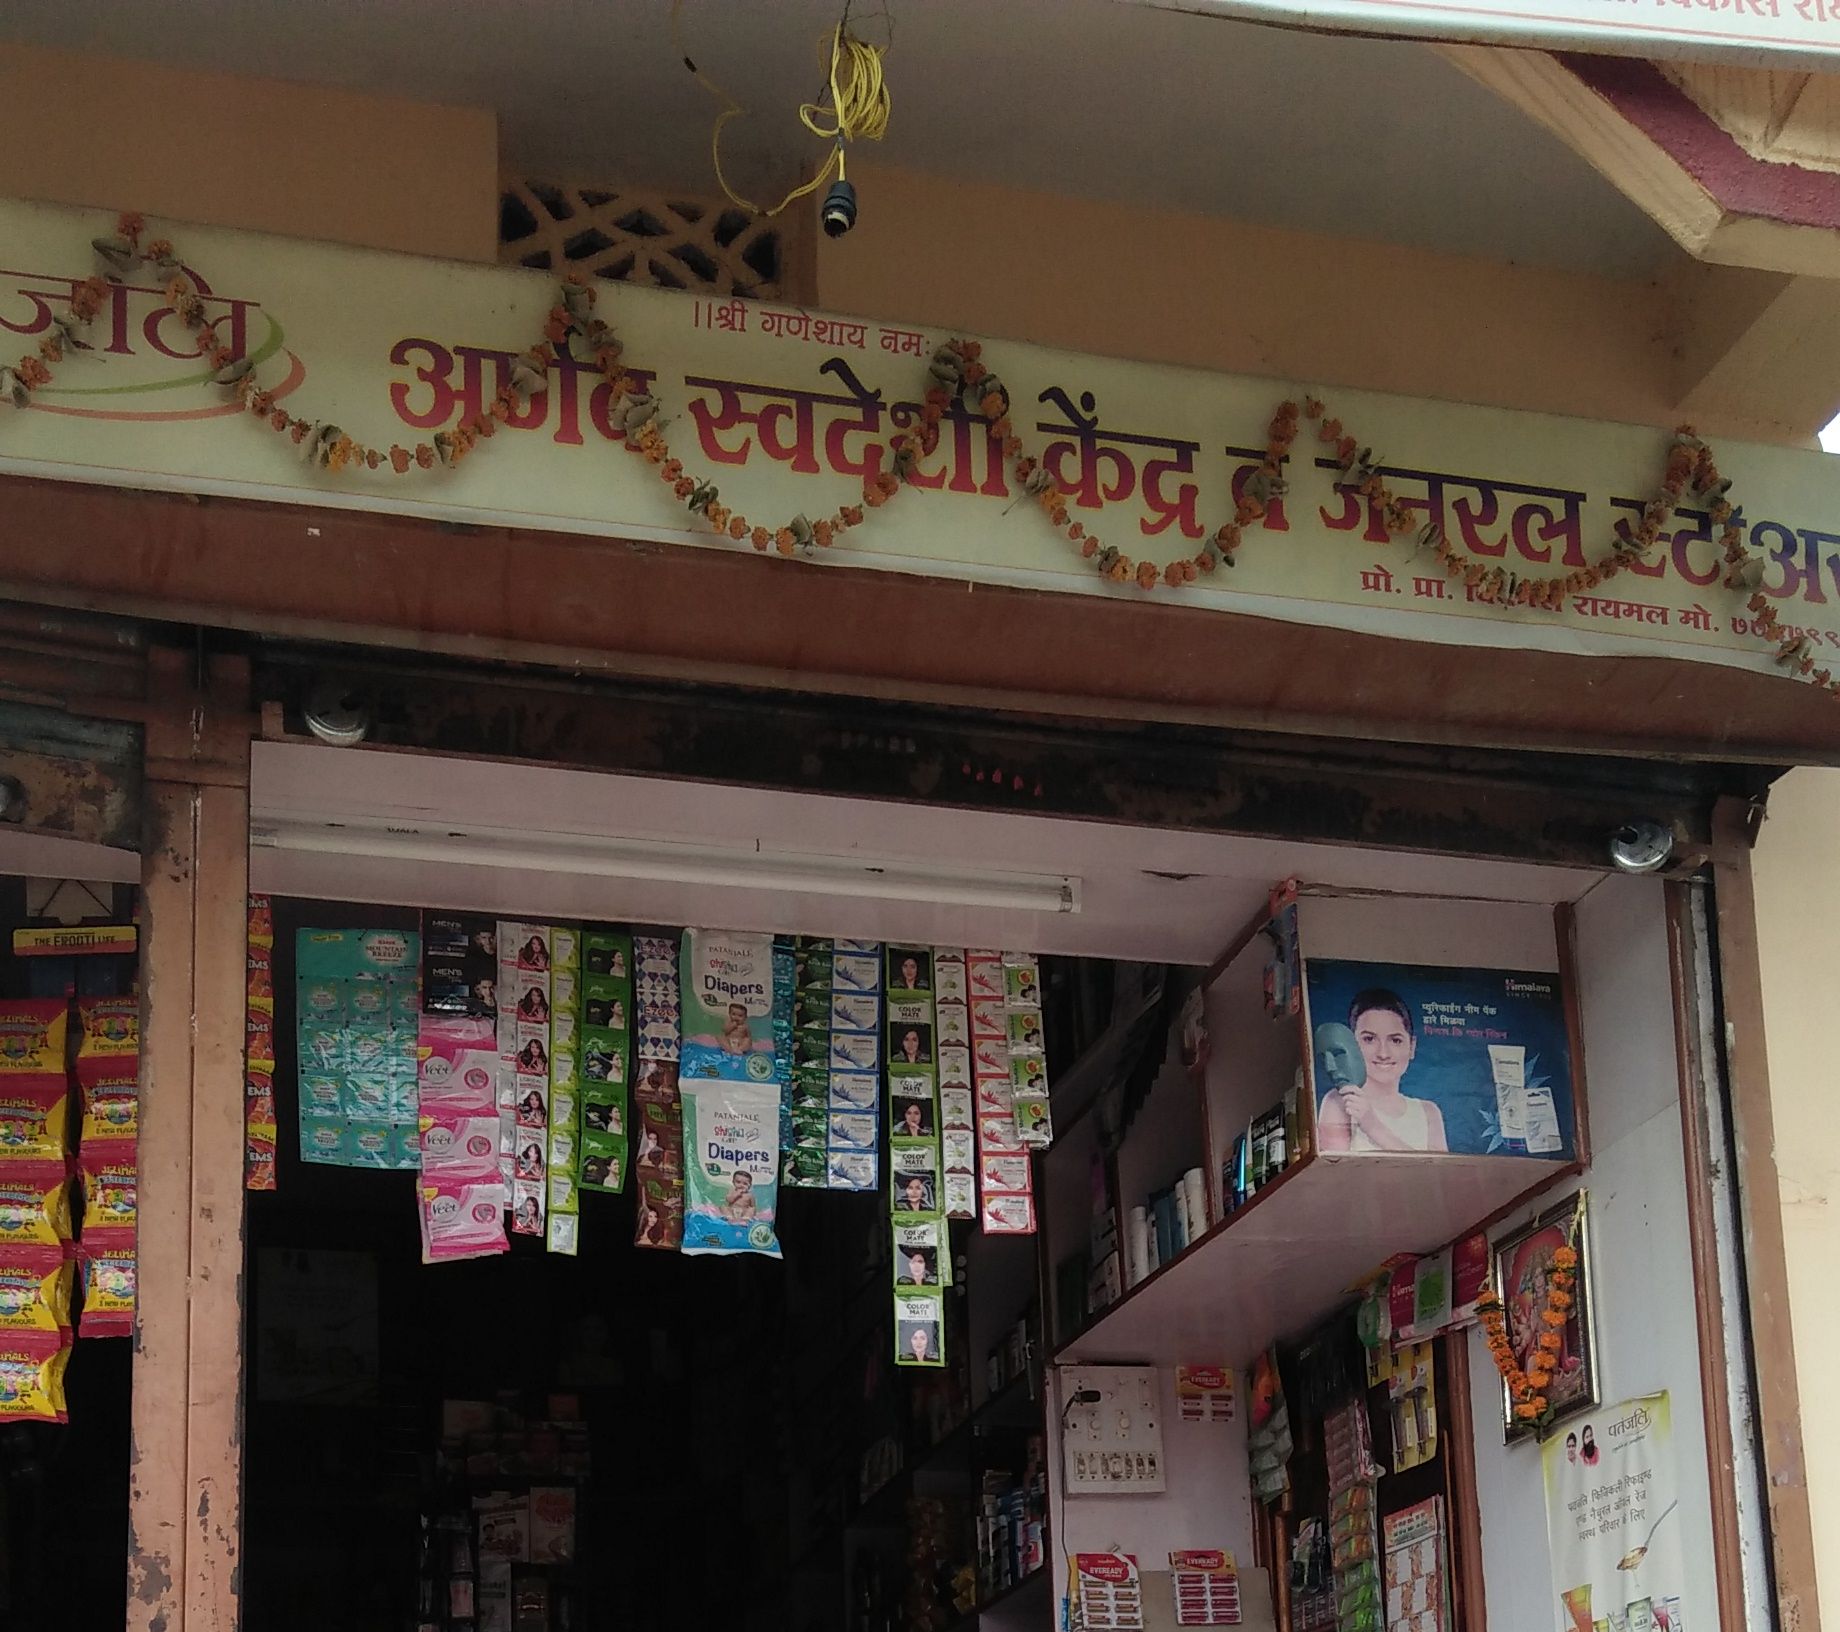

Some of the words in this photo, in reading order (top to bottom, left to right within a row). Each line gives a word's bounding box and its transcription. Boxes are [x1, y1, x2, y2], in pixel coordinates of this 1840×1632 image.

[759, 310, 869, 349] गणेशाय
[684, 357, 1010, 498] स्वदेशी
[1035, 385, 1204, 539] केंद्र
[1224, 445, 1290, 533] व
[1313, 456, 1588, 569] जनरल
[1359, 563, 1402, 594] प्रो.
[1412, 576, 1454, 600] प्रा.
[1572, 594, 1670, 626] रायमल
[1678, 603, 1720, 633] मो.
[247, 960, 269, 970] EMS
[703, 974, 764, 998] Diapers
[247, 1022, 269, 1032] EMS
[424, 1062, 449, 1076] Veet
[247, 1086, 272, 1097] EMS
[426, 1134, 452, 1146] Veet
[248, 1151, 273, 1162] EMS
[708, 1142, 770, 1166] Diapers
[432, 1200, 457, 1215] Veet
[103, 1248, 136, 1259] JELIMA
[1608, 1407, 1650, 1437] पतंजलि
[1089, 1566, 1123, 1576] EVEREADY
